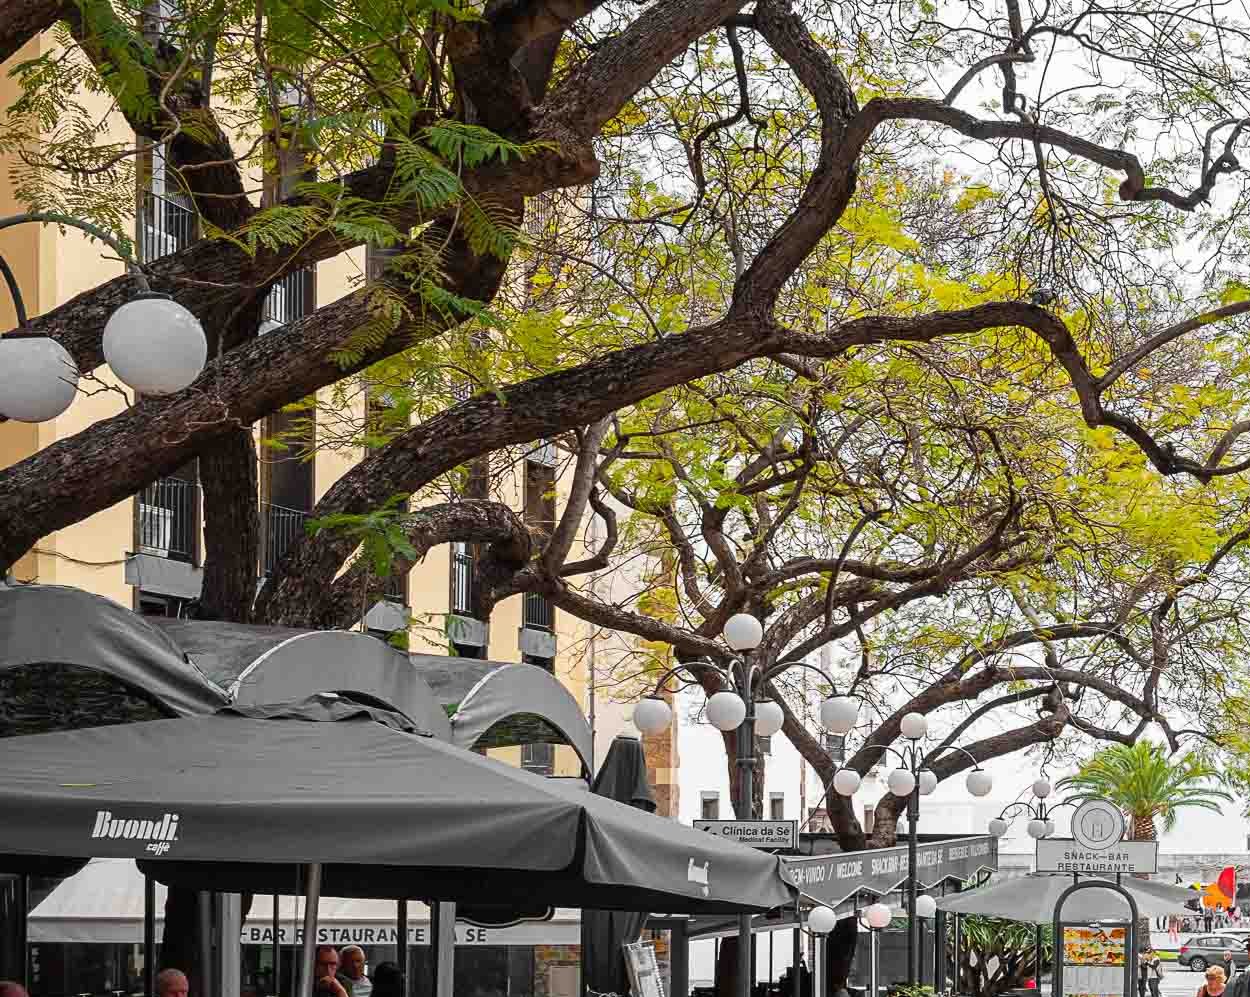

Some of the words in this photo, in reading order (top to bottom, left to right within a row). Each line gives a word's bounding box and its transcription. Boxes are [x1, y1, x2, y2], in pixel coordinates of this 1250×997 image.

[92, 811, 179, 841] Buondi
[760, 826, 774, 836] da
[1057, 862, 1135, 872] RESTAURANTE
[295, 928, 425, 942] RSTAURANTE
[465, 928, 486, 942] SE
